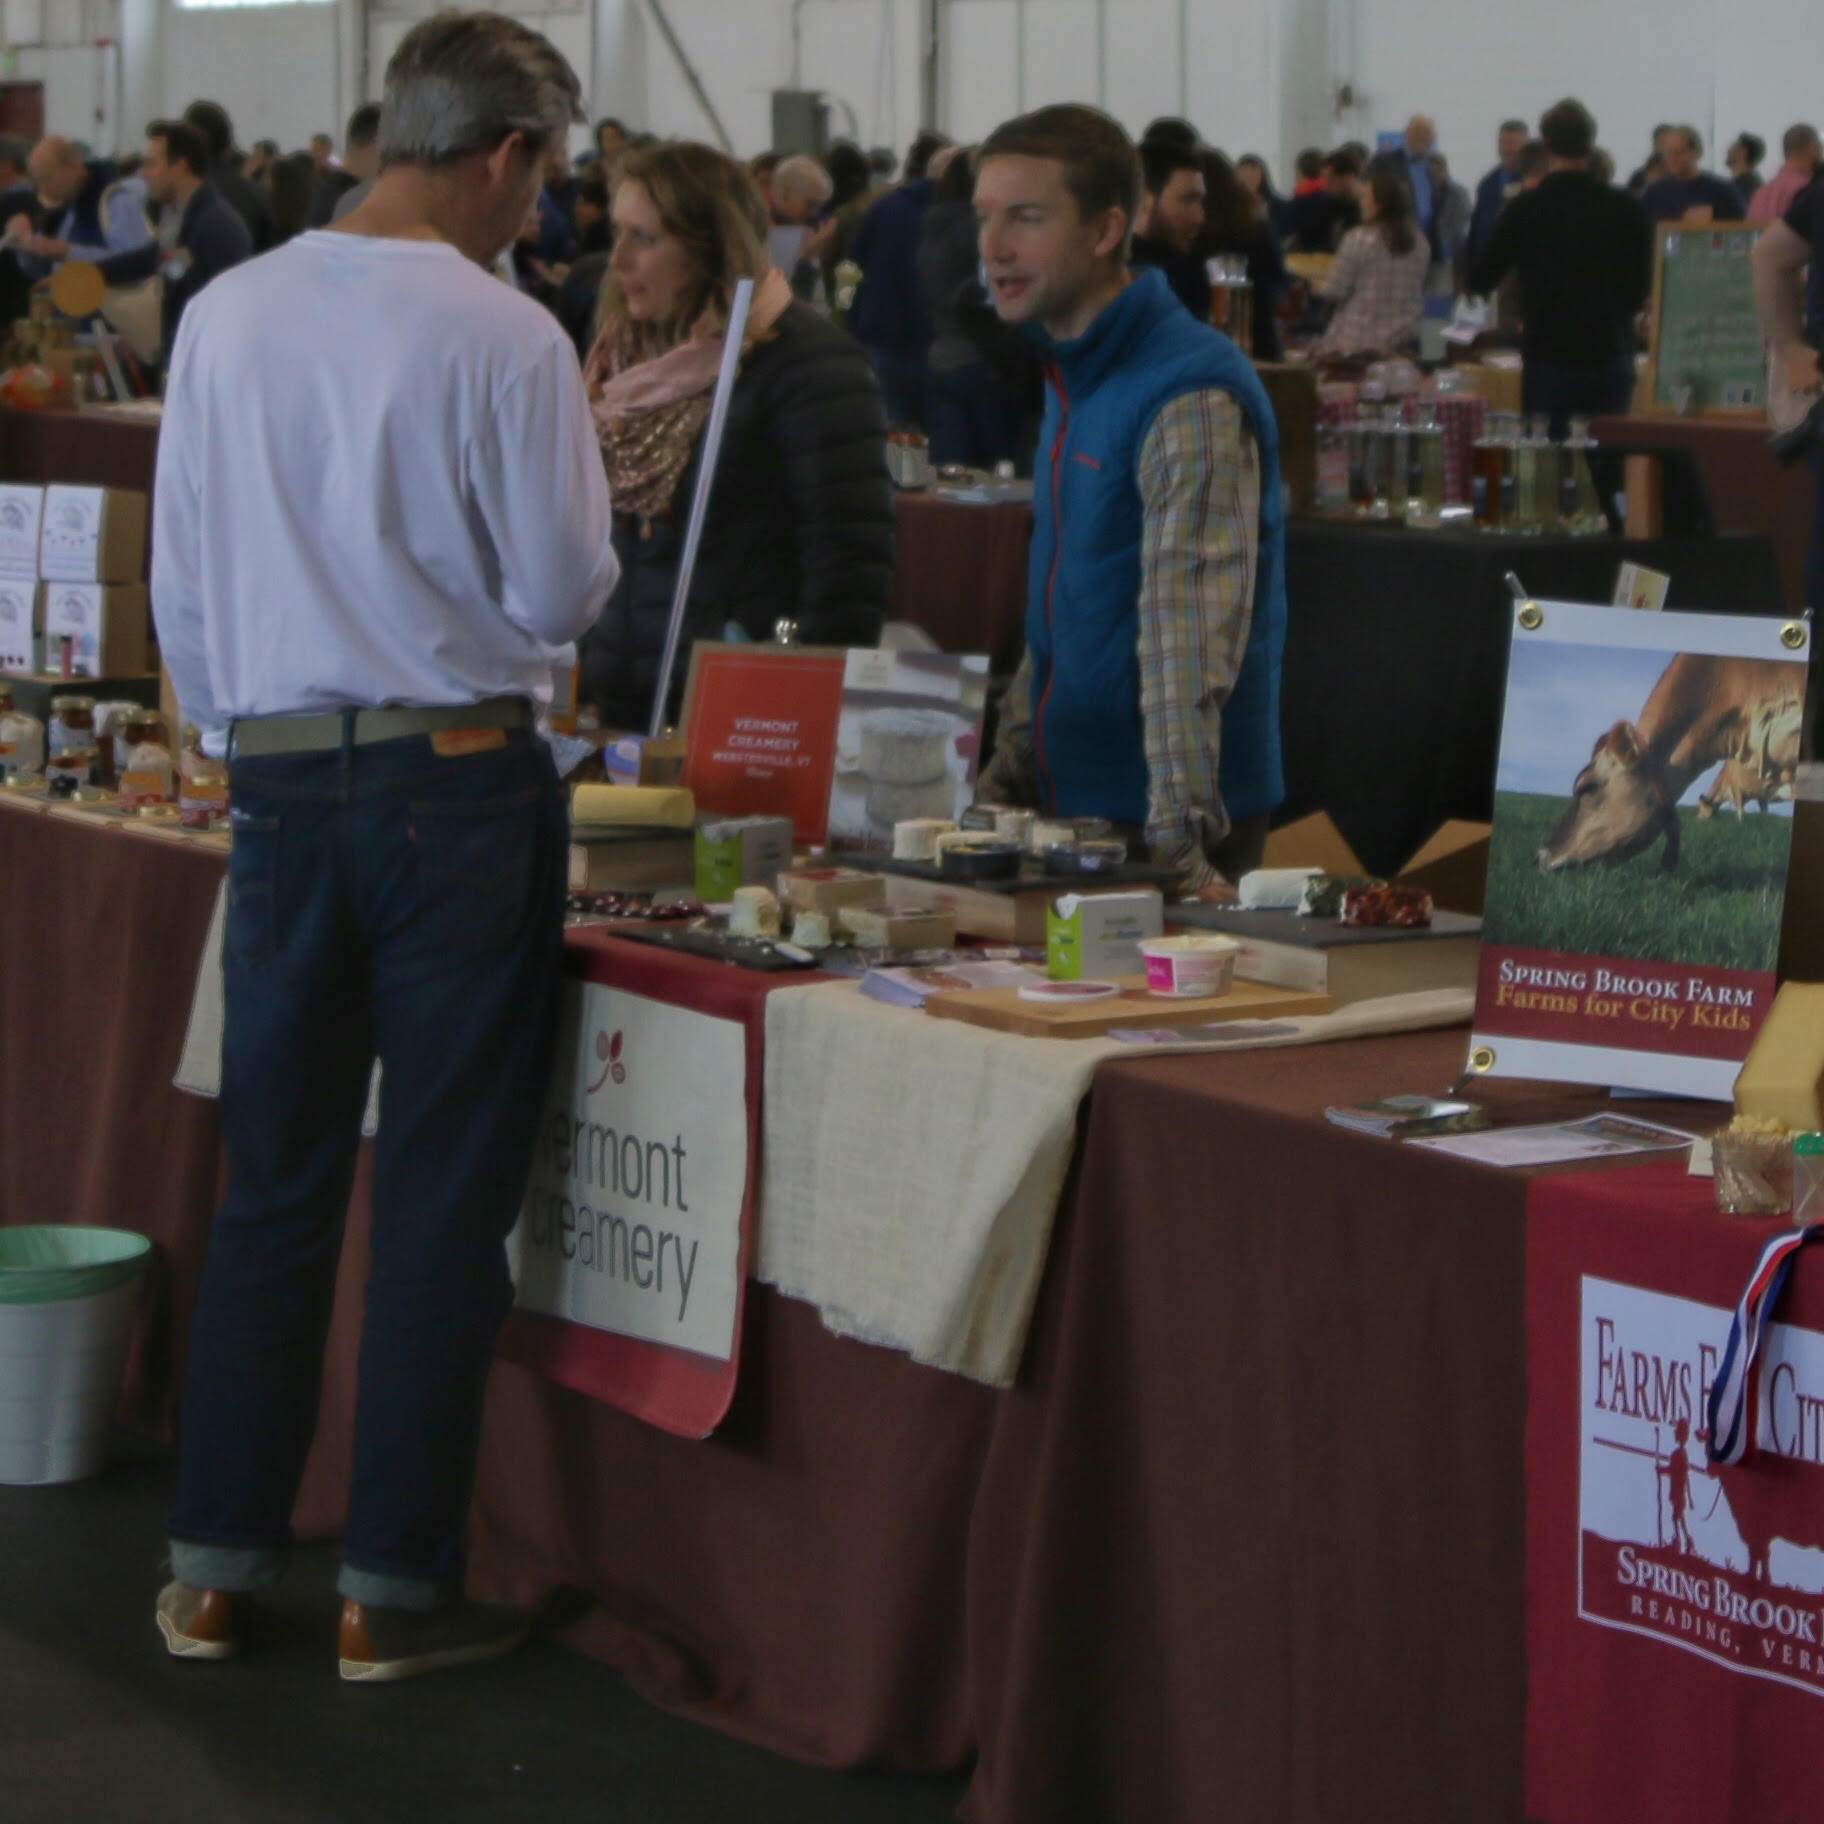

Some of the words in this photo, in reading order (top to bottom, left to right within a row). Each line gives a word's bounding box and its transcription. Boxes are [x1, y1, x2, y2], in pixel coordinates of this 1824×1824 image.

[1496, 984, 1578, 1014] Farms
[1585, 994, 1622, 1018] for
[1630, 999, 1685, 1030] City
[1691, 1004, 1752, 1031] Kids
[1500, 959, 1586, 990] SPRING
[1595, 969, 1678, 999] BROOK
[1686, 980, 1753, 1006] FARM
[1594, 1316, 1692, 1428] FARMS
[1616, 1546, 1711, 1610] SPRING
[1713, 1577, 1817, 1643] BROOK
[1630, 1594, 1741, 1654] READING,
